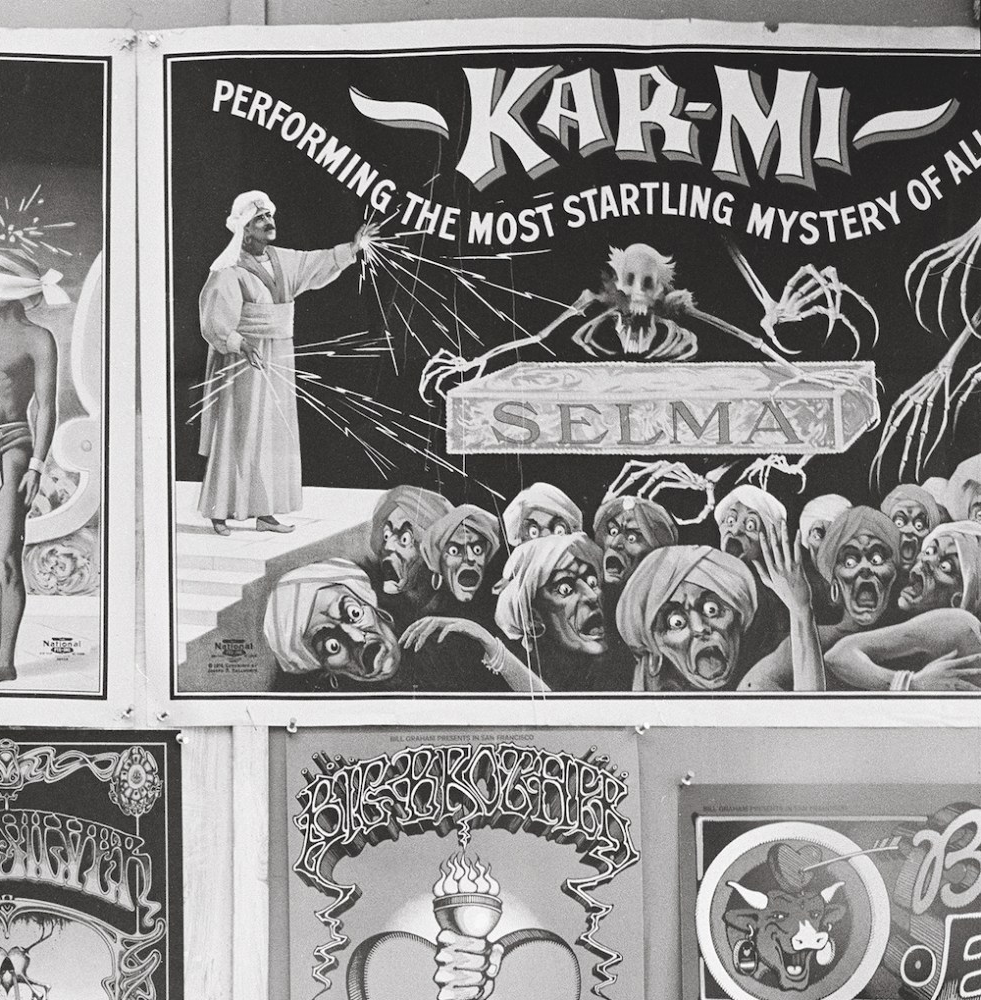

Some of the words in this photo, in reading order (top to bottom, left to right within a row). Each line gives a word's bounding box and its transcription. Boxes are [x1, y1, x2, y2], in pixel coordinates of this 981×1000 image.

[212, 79, 395, 213] PERFORMING
[402, 191, 457, 242] THE
[467, 203, 555, 246] MOST
[563, 181, 735, 229] STARTLING
[748, 190, 901, 245] MYSTERY
[907, 164, 944, 211] OF
[455, 64, 852, 192] KAR-MI
[491, 402, 803, 447] SELMA
